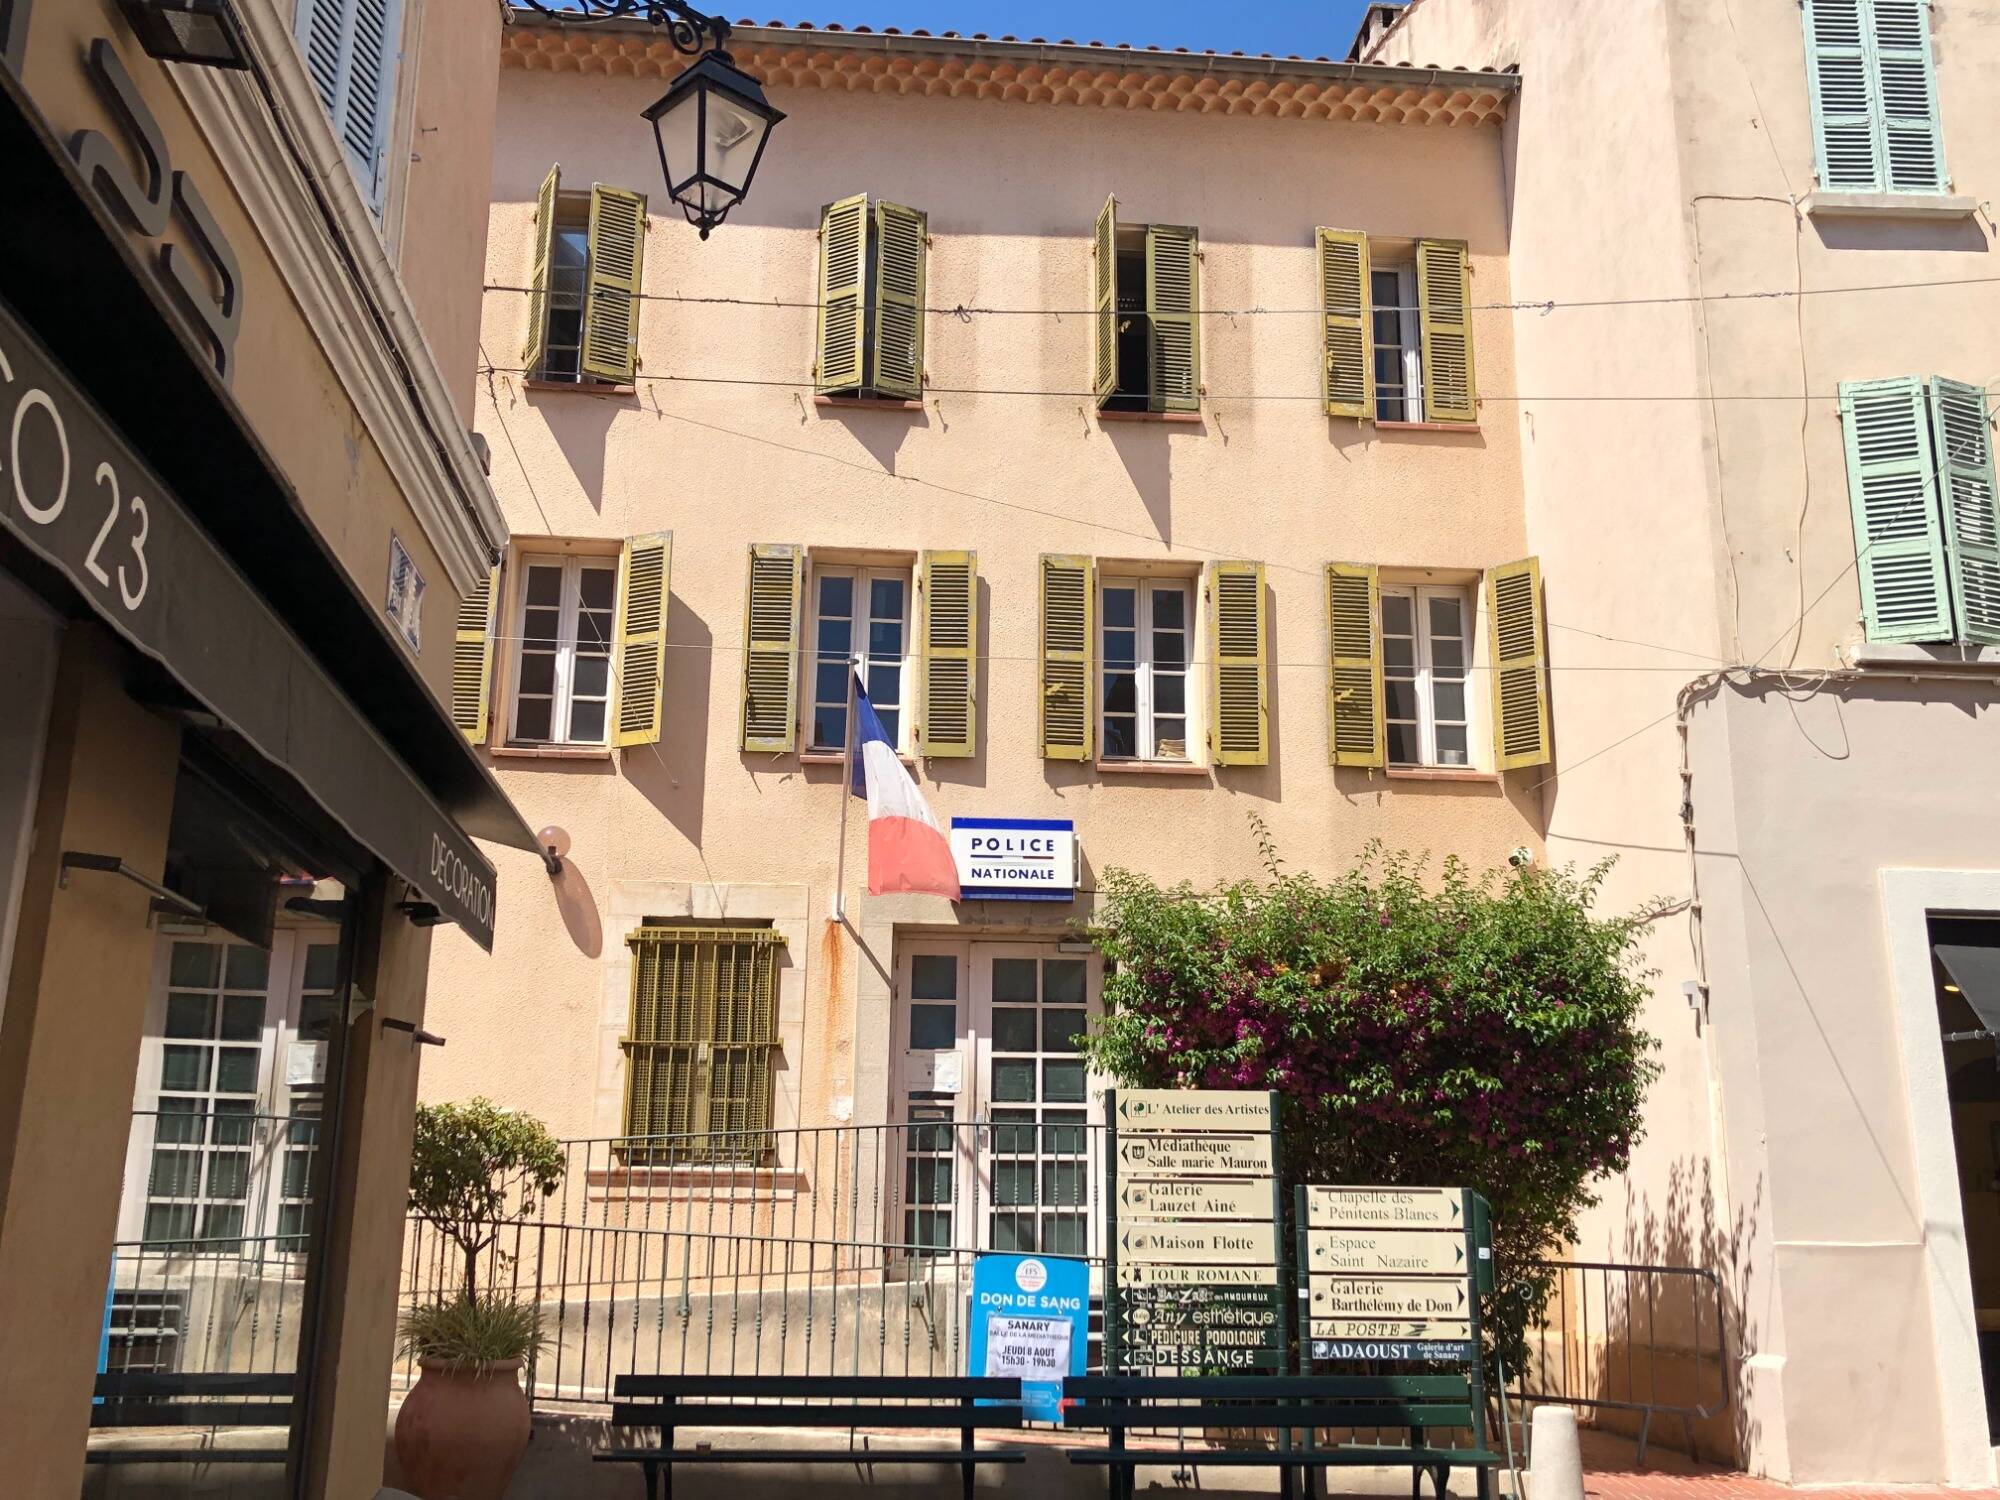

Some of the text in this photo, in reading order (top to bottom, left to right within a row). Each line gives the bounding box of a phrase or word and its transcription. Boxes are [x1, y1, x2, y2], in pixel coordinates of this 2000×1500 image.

[84, 461, 148, 611] 23
[971, 837, 1054, 852] POLICE
[971, 868, 1054, 880] NATIONALE
[430, 833, 494, 931] DECORATION
[1163, 1103, 1202, 1115] Atelier
[1204, 1103, 1223, 1115] des
[1225, 1104, 1269, 1115] Artistes
[1148, 1138, 1231, 1155] Médiathèque
[1147, 1156, 1268, 1169] Salle marie Mauron
[1149, 1182, 1203, 1196] Galerie
[1328, 1191, 1414, 1205] Chapelle des
[1150, 1199, 1196, 1212] Lauzet
[1329, 1207, 1439, 1221] Pénitents Blancs
[1150, 1236, 1254, 1250] Maison Flotte
[1330, 1236, 1376, 1251] Espace
[1330, 1255, 1429, 1268] Saint Nazaire
[1149, 1268, 1262, 1281] TOUR ROMANE
[1330, 1281, 1384, 1296] Galerie
[980, 1292, 1081, 1310] DON DE SANG
[1407, 1299, 1422, 1312] de
[1426, 1299, 1453, 1312] Don
[1152, 1308, 1187, 1327] Any
[1008, 1320, 1051, 1331] SANARY
[1315, 1322, 1401, 1337] LA POSTE
[1151, 1329, 1201, 1345] PEDICURE
[1003, 1345, 1056, 1357] JEUDI 8 AOUT
[1156, 1349, 1254, 1365] DESSANGE
[1329, 1342, 1465, 1359] ADAOUST Galerie d'art
[1423, 1351, 1460, 1361] de Sanary
[1001, 1355, 1025, 1366] 15h30
[1033, 1357, 1056, 1368] 19h30
